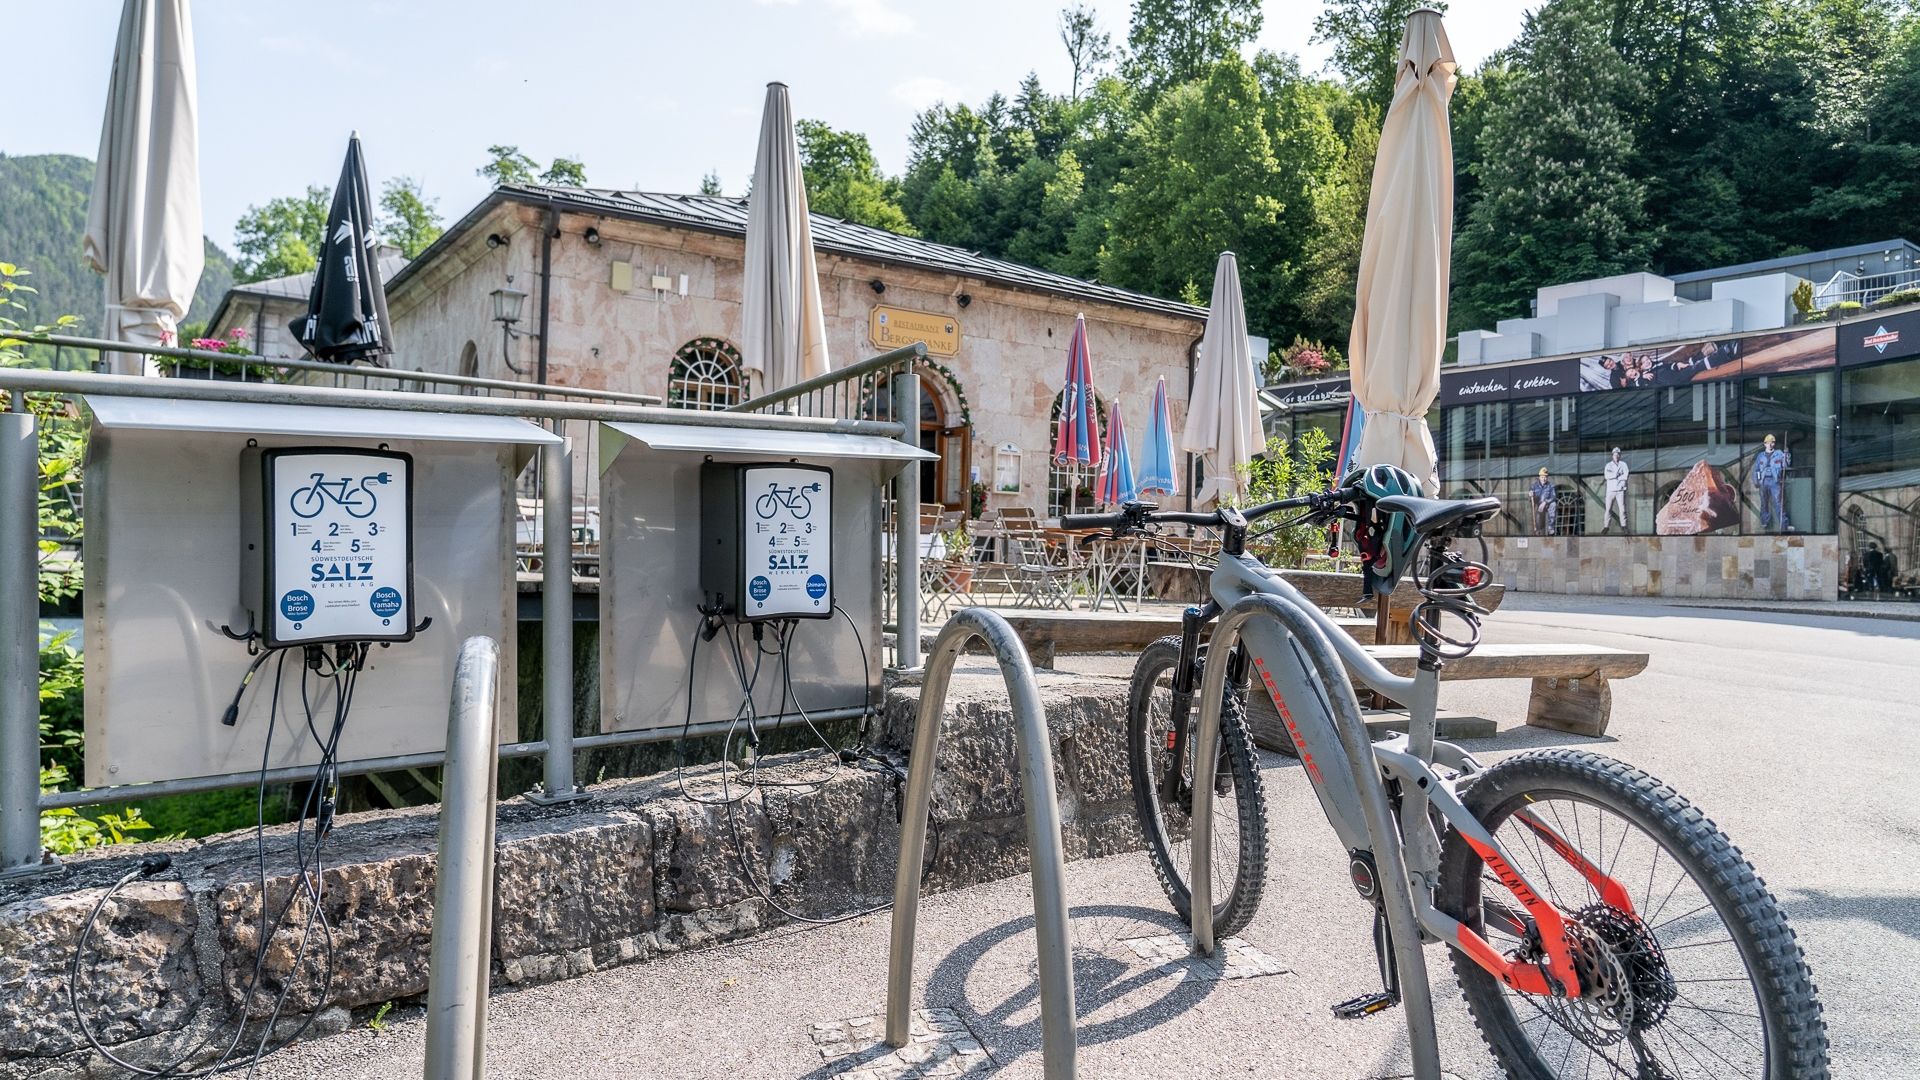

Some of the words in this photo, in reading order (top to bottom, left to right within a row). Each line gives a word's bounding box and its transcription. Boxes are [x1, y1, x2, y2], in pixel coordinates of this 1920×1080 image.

[1459, 378, 1508, 395] eintauchen
[1514, 379, 1521, 389] &
[1523, 375, 1560, 389] erleben
[1670, 487, 1696, 504] 500
[290, 522, 297, 536] 1
[328, 522, 339, 536] 2
[368, 521, 378, 536] 3
[755, 522, 760, 534] 1
[779, 522, 787, 534] 2
[805, 522, 812, 534] 3
[311, 539, 322, 553] 4
[350, 539, 361, 553] 5
[768, 536, 776, 547] 4
[793, 535, 801, 547] 5
[768, 554, 809, 570] SALZ
[311, 562, 374, 582] SALZ
[286, 594, 309, 602] Bosch
[375, 591, 396, 599] Bosch
[372, 600, 400, 608] Yamaha
[1484, 856, 1540, 906] ALLMTN
